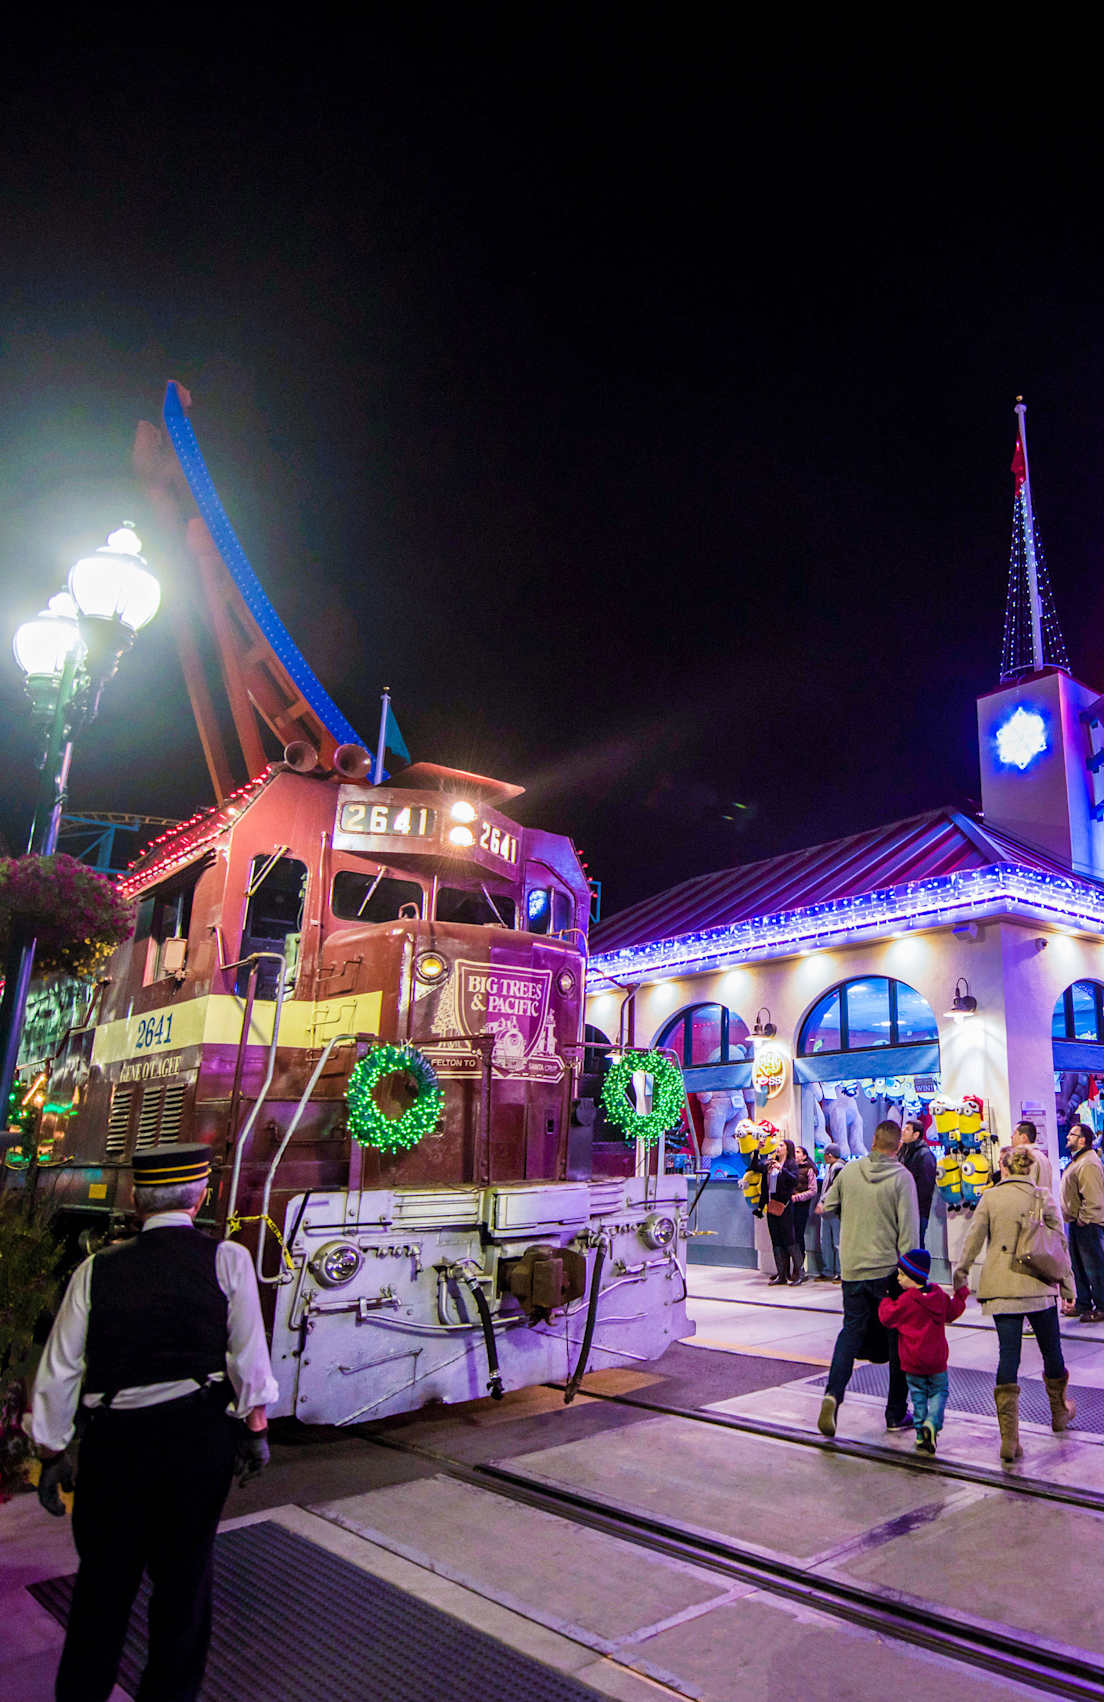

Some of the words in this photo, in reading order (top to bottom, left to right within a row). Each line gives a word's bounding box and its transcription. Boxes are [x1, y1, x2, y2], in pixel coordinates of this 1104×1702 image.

[348, 804, 429, 836] 2641
[480, 822, 517, 864] 2641
[468, 975, 498, 994] BIG
[499, 977, 542, 1000] TREES
[470, 993, 487, 1011] &
[487, 995, 540, 1017] PACIFIC
[136, 1012, 173, 1049] 2641
[431, 1058, 463, 1068] FELTON
[465, 1058, 476, 1068] TO
